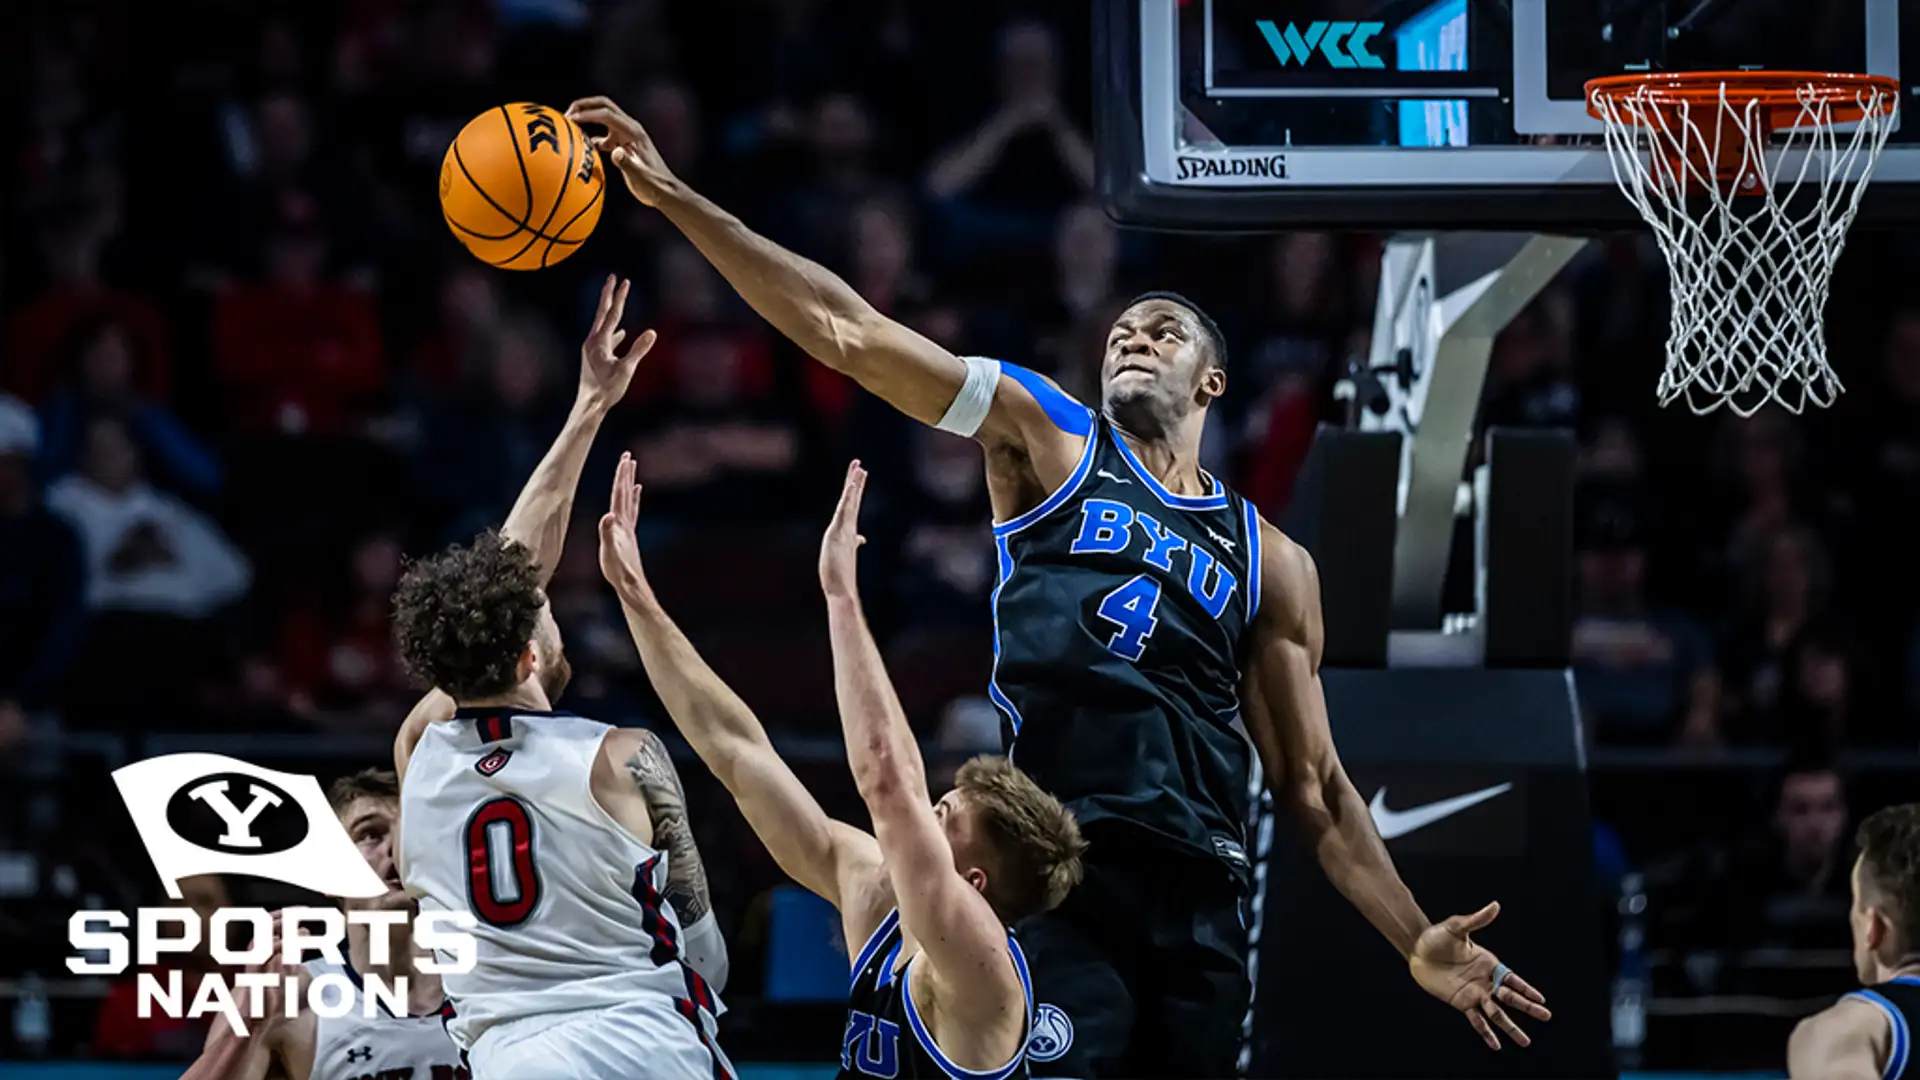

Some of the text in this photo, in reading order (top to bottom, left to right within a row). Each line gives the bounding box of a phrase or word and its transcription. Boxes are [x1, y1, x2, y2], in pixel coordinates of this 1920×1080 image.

[1256, 20, 1385, 69] WCC
[1177, 154, 1287, 180] SPALDING
[1070, 499, 1238, 620] BYU
[1097, 573, 1162, 662] 4
[464, 797, 540, 927] 0
